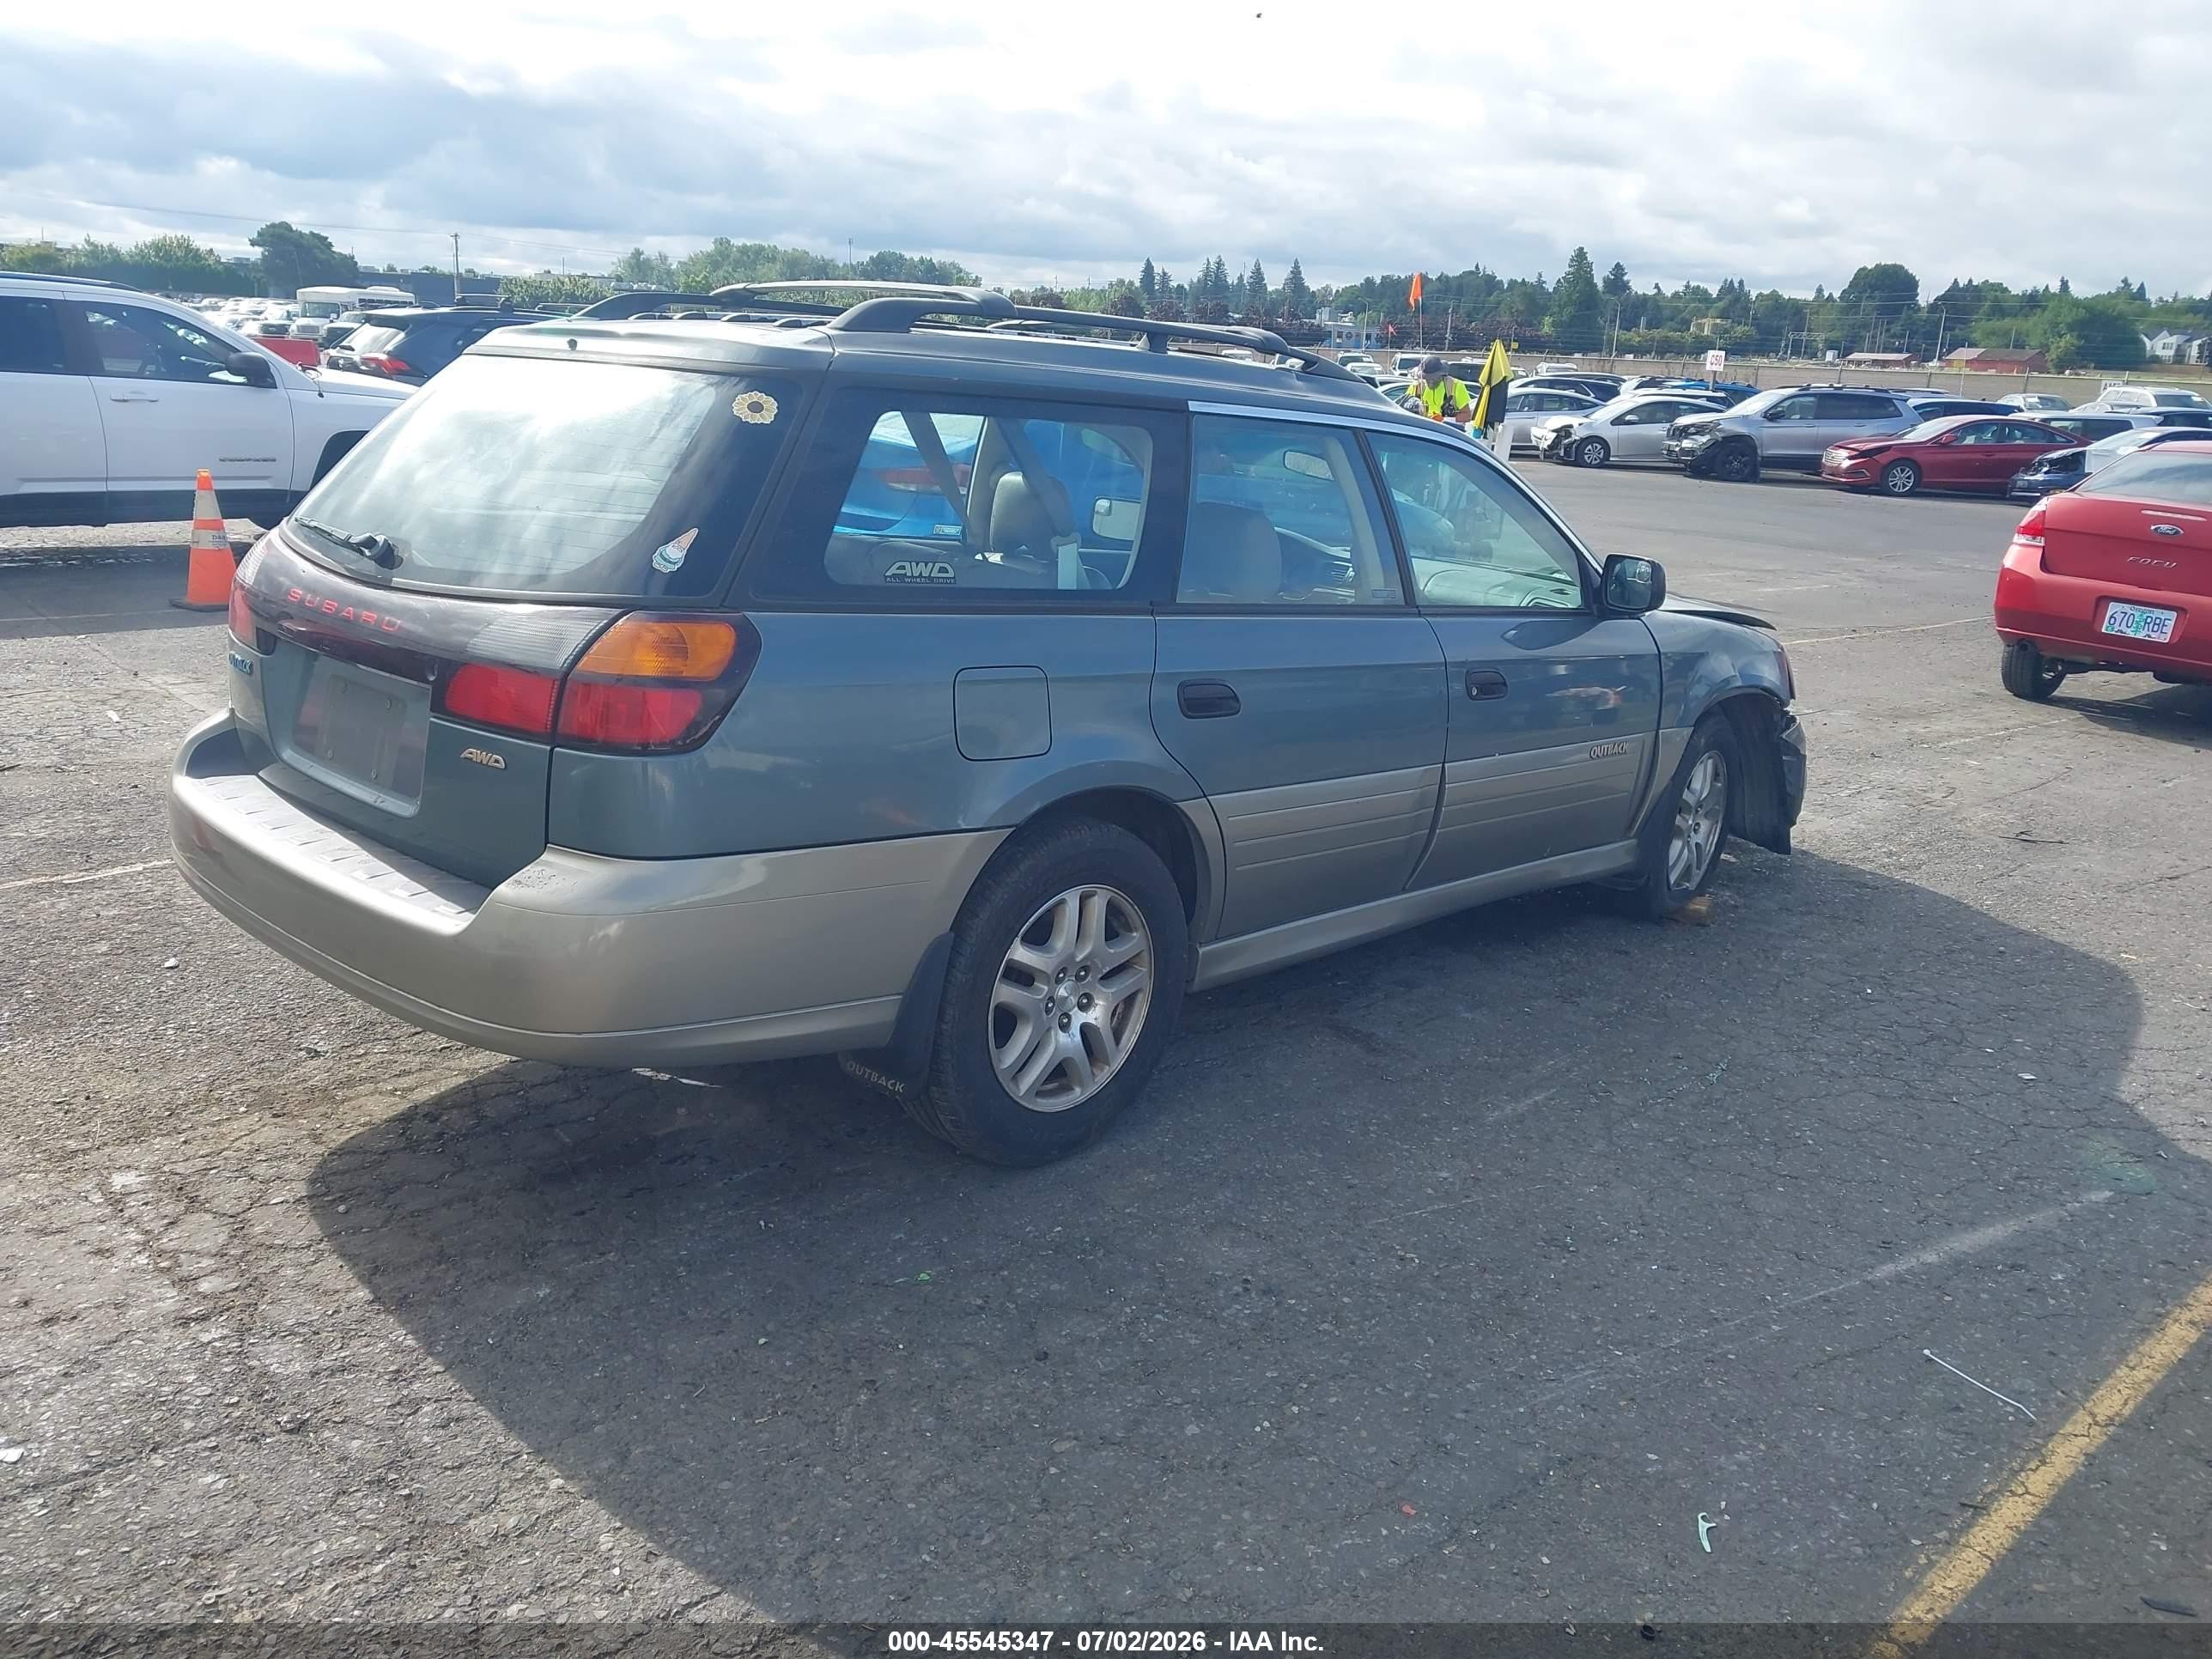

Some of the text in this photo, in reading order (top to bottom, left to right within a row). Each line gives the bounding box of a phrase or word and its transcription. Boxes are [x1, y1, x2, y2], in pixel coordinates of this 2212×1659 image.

[1710, 354, 1723, 366] C50
[884, 561, 955, 577] AWD
[288, 586, 402, 632] SUBARU
[2108, 611, 2172, 635] 670 RBE
[459, 748, 506, 769] AWD
[1590, 741, 1629, 758] OUTBACK
[847, 1060, 905, 1093] OUTBACK
